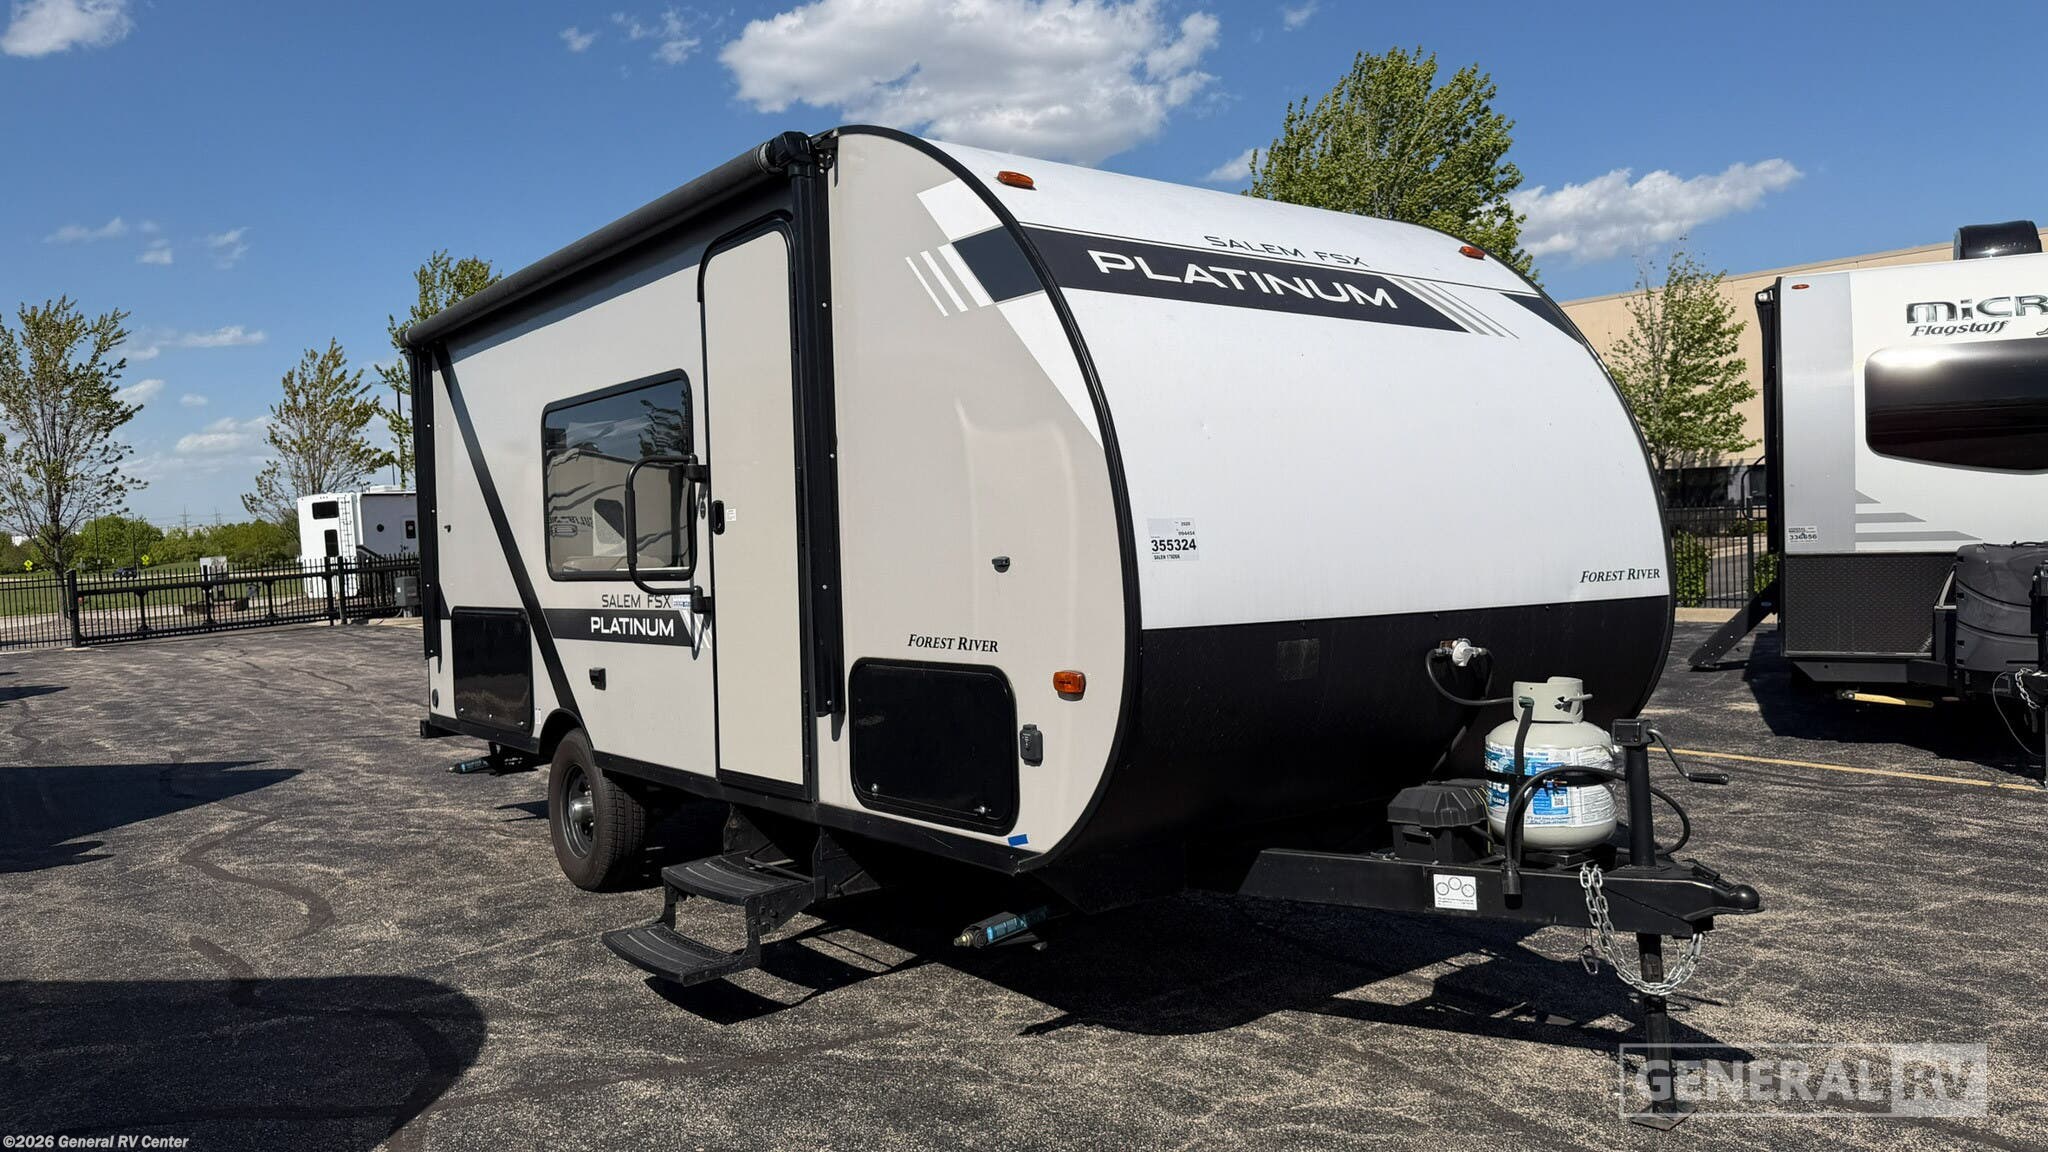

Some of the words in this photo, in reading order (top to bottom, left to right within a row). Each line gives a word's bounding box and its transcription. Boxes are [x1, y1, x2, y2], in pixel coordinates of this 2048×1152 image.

[1203, 235, 1304, 258] SALEM
[1313, 250, 1369, 267] FSX
[1087, 250, 1398, 309] PLATINUM
[1911, 320, 2009, 336] Flagstaff
[1151, 538, 1196, 551] 355324
[1579, 570, 1625, 583] FOREST
[1627, 568, 1660, 580] RIVER
[601, 593, 640, 608] SALEM
[647, 595, 671, 608] FSX
[590, 616, 674, 637] PLATINUM
[907, 633, 955, 650] FOREST
[957, 636, 998, 653] RIVER
